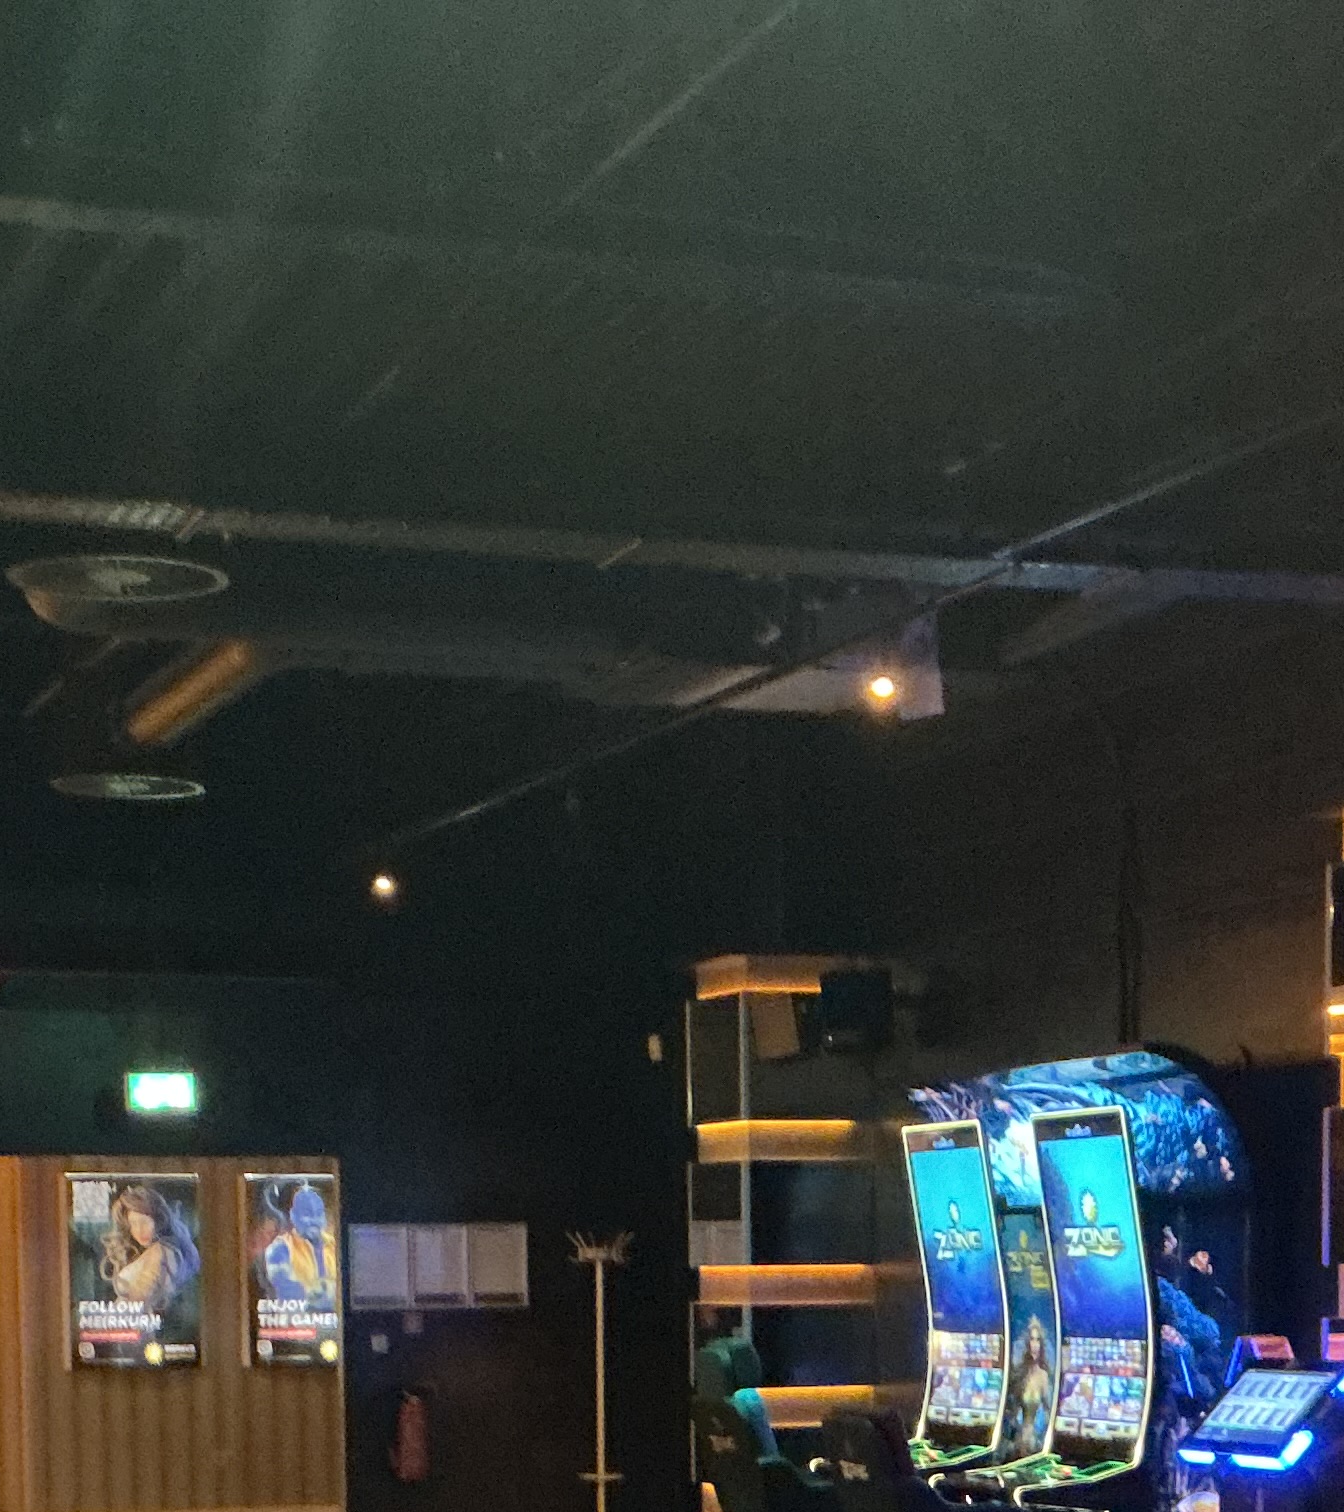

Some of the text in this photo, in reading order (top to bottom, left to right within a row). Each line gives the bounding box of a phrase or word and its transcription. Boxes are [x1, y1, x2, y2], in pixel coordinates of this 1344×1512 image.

[79, 1300, 144, 1314] FOLLOW
[257, 1299, 306, 1313] ENJOY
[258, 1312, 339, 1329] THE GAME!
